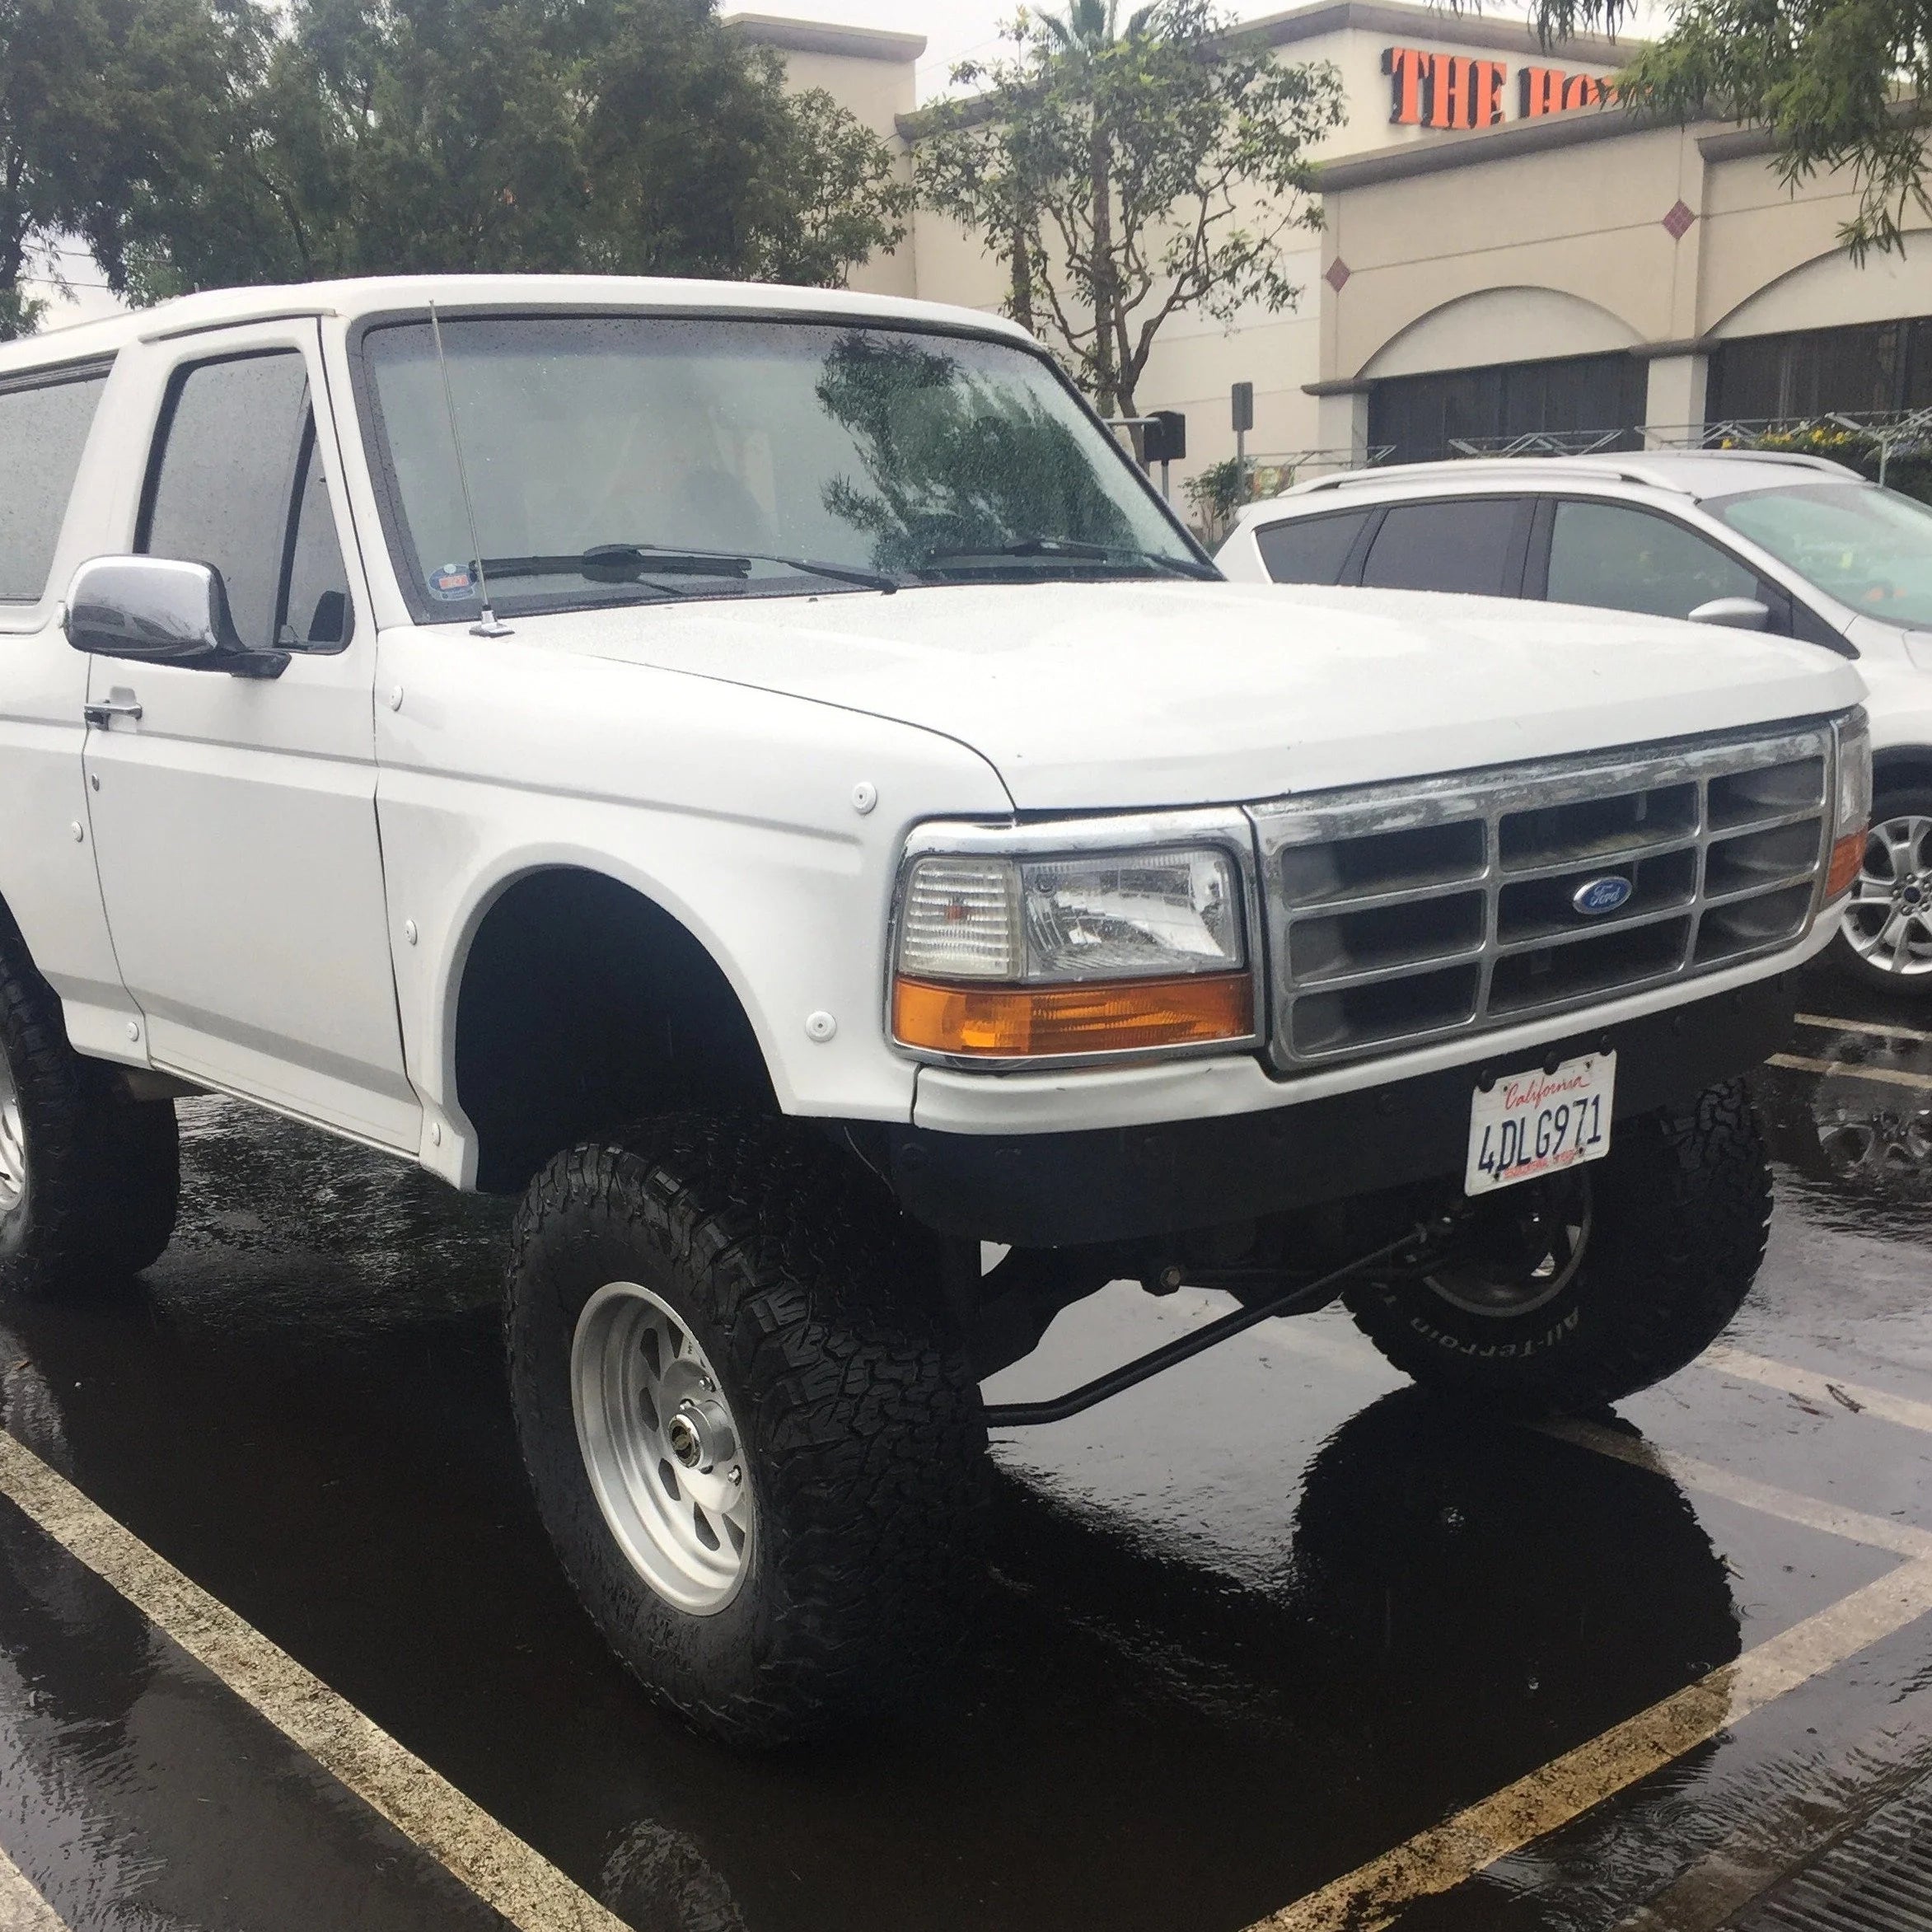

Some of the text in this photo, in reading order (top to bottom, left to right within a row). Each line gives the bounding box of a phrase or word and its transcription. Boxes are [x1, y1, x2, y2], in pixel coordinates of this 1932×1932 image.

[1381, 46, 1507, 130] THE
[1588, 883, 1622, 907] Ford
[1504, 1075, 1590, 1110] California
[1478, 1093, 1602, 1174] 4DLG971
[1410, 1305, 1581, 1358] All-Terrain
